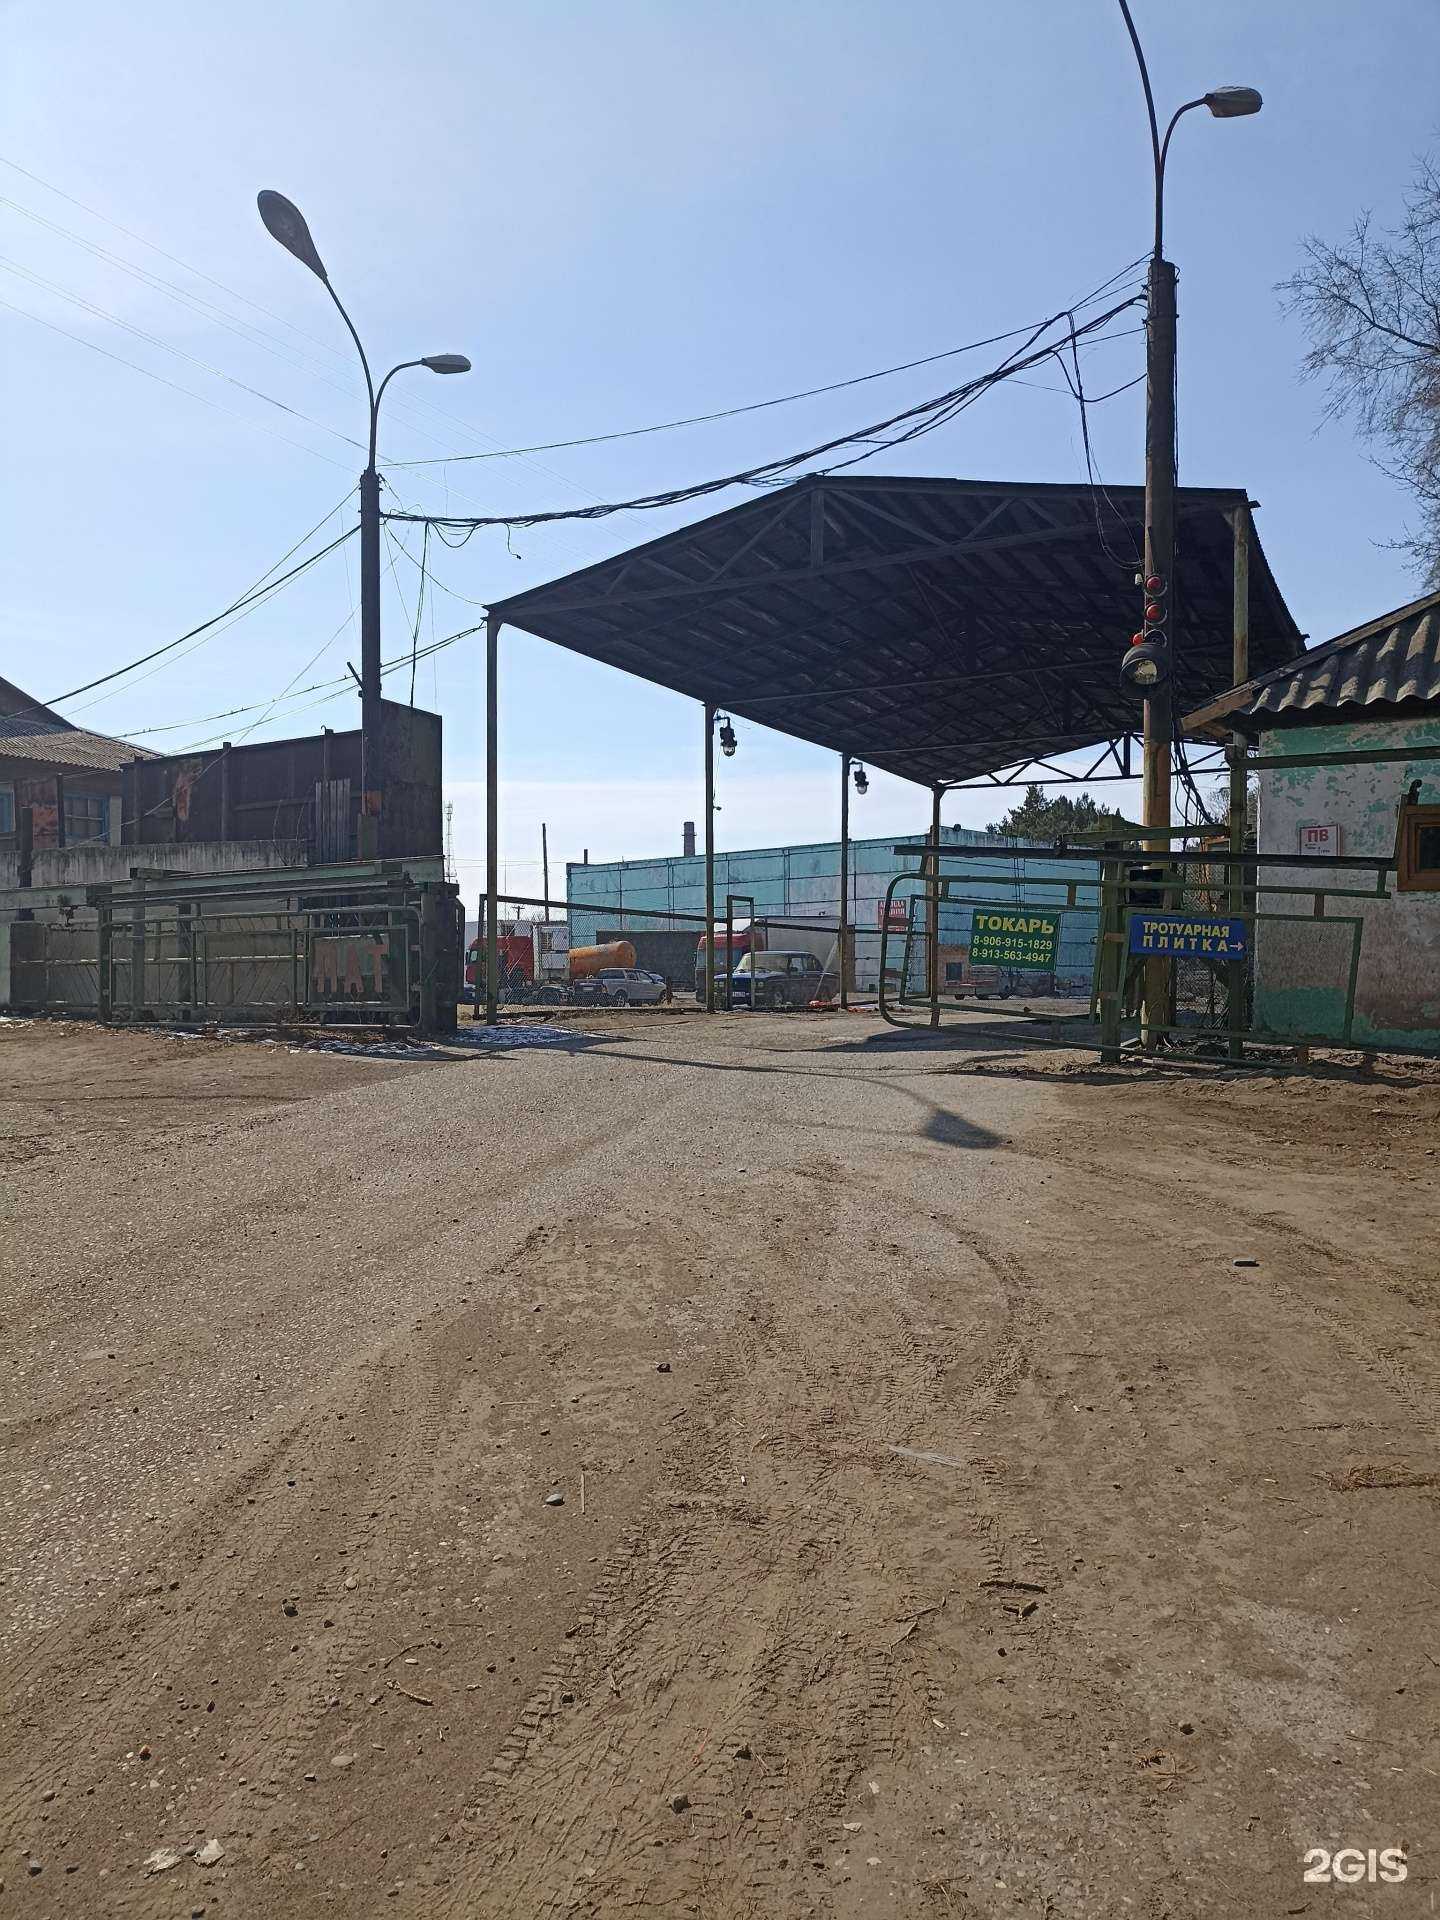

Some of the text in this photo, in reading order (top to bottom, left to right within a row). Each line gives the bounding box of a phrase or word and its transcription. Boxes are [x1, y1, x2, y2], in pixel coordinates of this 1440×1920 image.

[1308, 829, 1328, 842] ПВ
[976, 915, 1054, 934] ТОКАРЬ
[1143, 922, 1230, 937] ТРОТУАРНАЯ
[973, 935, 1053, 950] 8-906-915-1829
[1143, 935, 1228, 952] ПЛИТКА
[972, 947, 1052, 963] 8-913-563-4947
